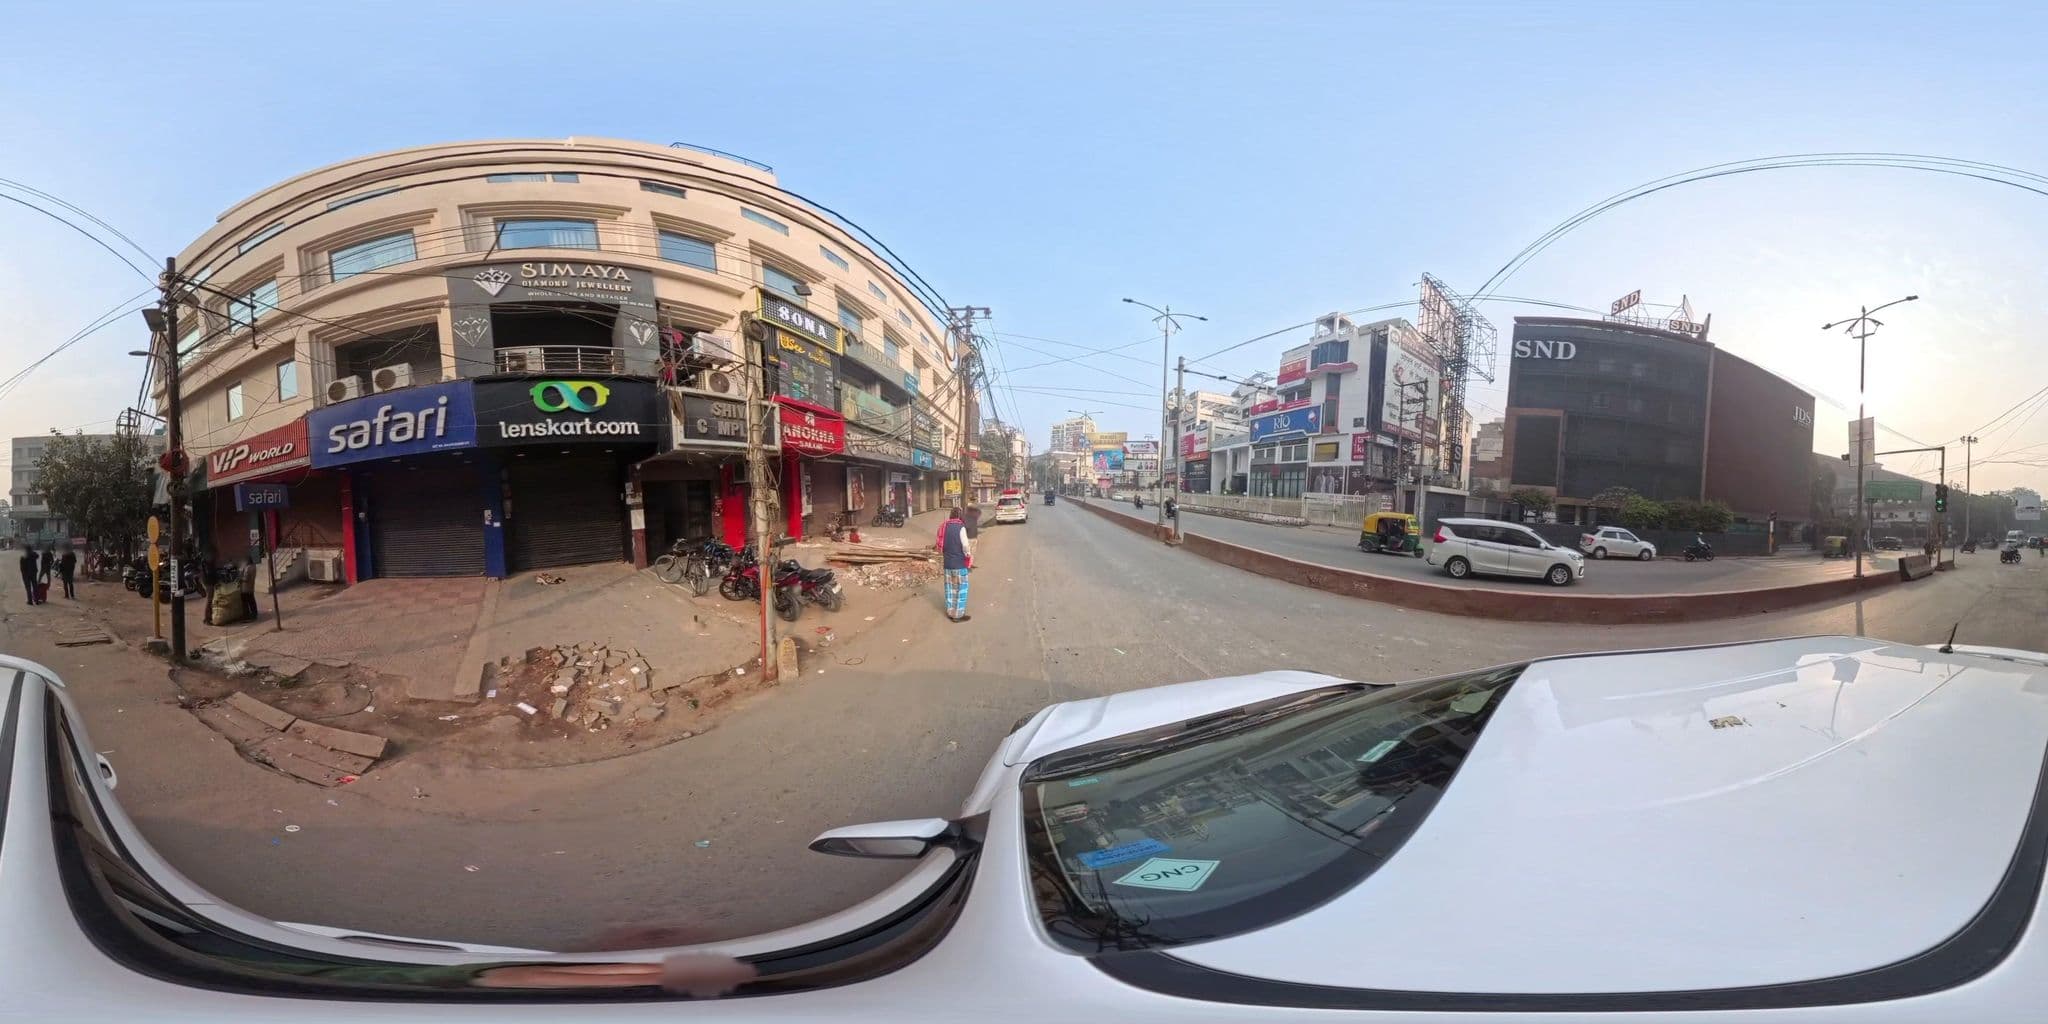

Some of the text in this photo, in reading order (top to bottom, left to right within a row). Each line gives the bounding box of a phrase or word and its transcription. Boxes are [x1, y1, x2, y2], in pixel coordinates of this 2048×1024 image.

[520, 263, 632, 281] SIMAYA
[522, 280, 632, 292] DIAMOND JEWELLERY
[1613, 292, 1640, 314] SND
[779, 306, 828, 340] SONA
[1670, 320, 1703, 333] SND
[1514, 340, 1577, 360] SND
[712, 402, 748, 419] SHIV
[1793, 406, 1811, 424] JDS
[328, 395, 448, 454] safari
[499, 418, 640, 438] lenskart.com
[783, 425, 835, 444] ANOKHA
[212, 444, 249, 473] VIP
[249, 442, 293, 464] WORLD
[248, 489, 282, 505] safari
[1140, 865, 1200, 882] CNG
